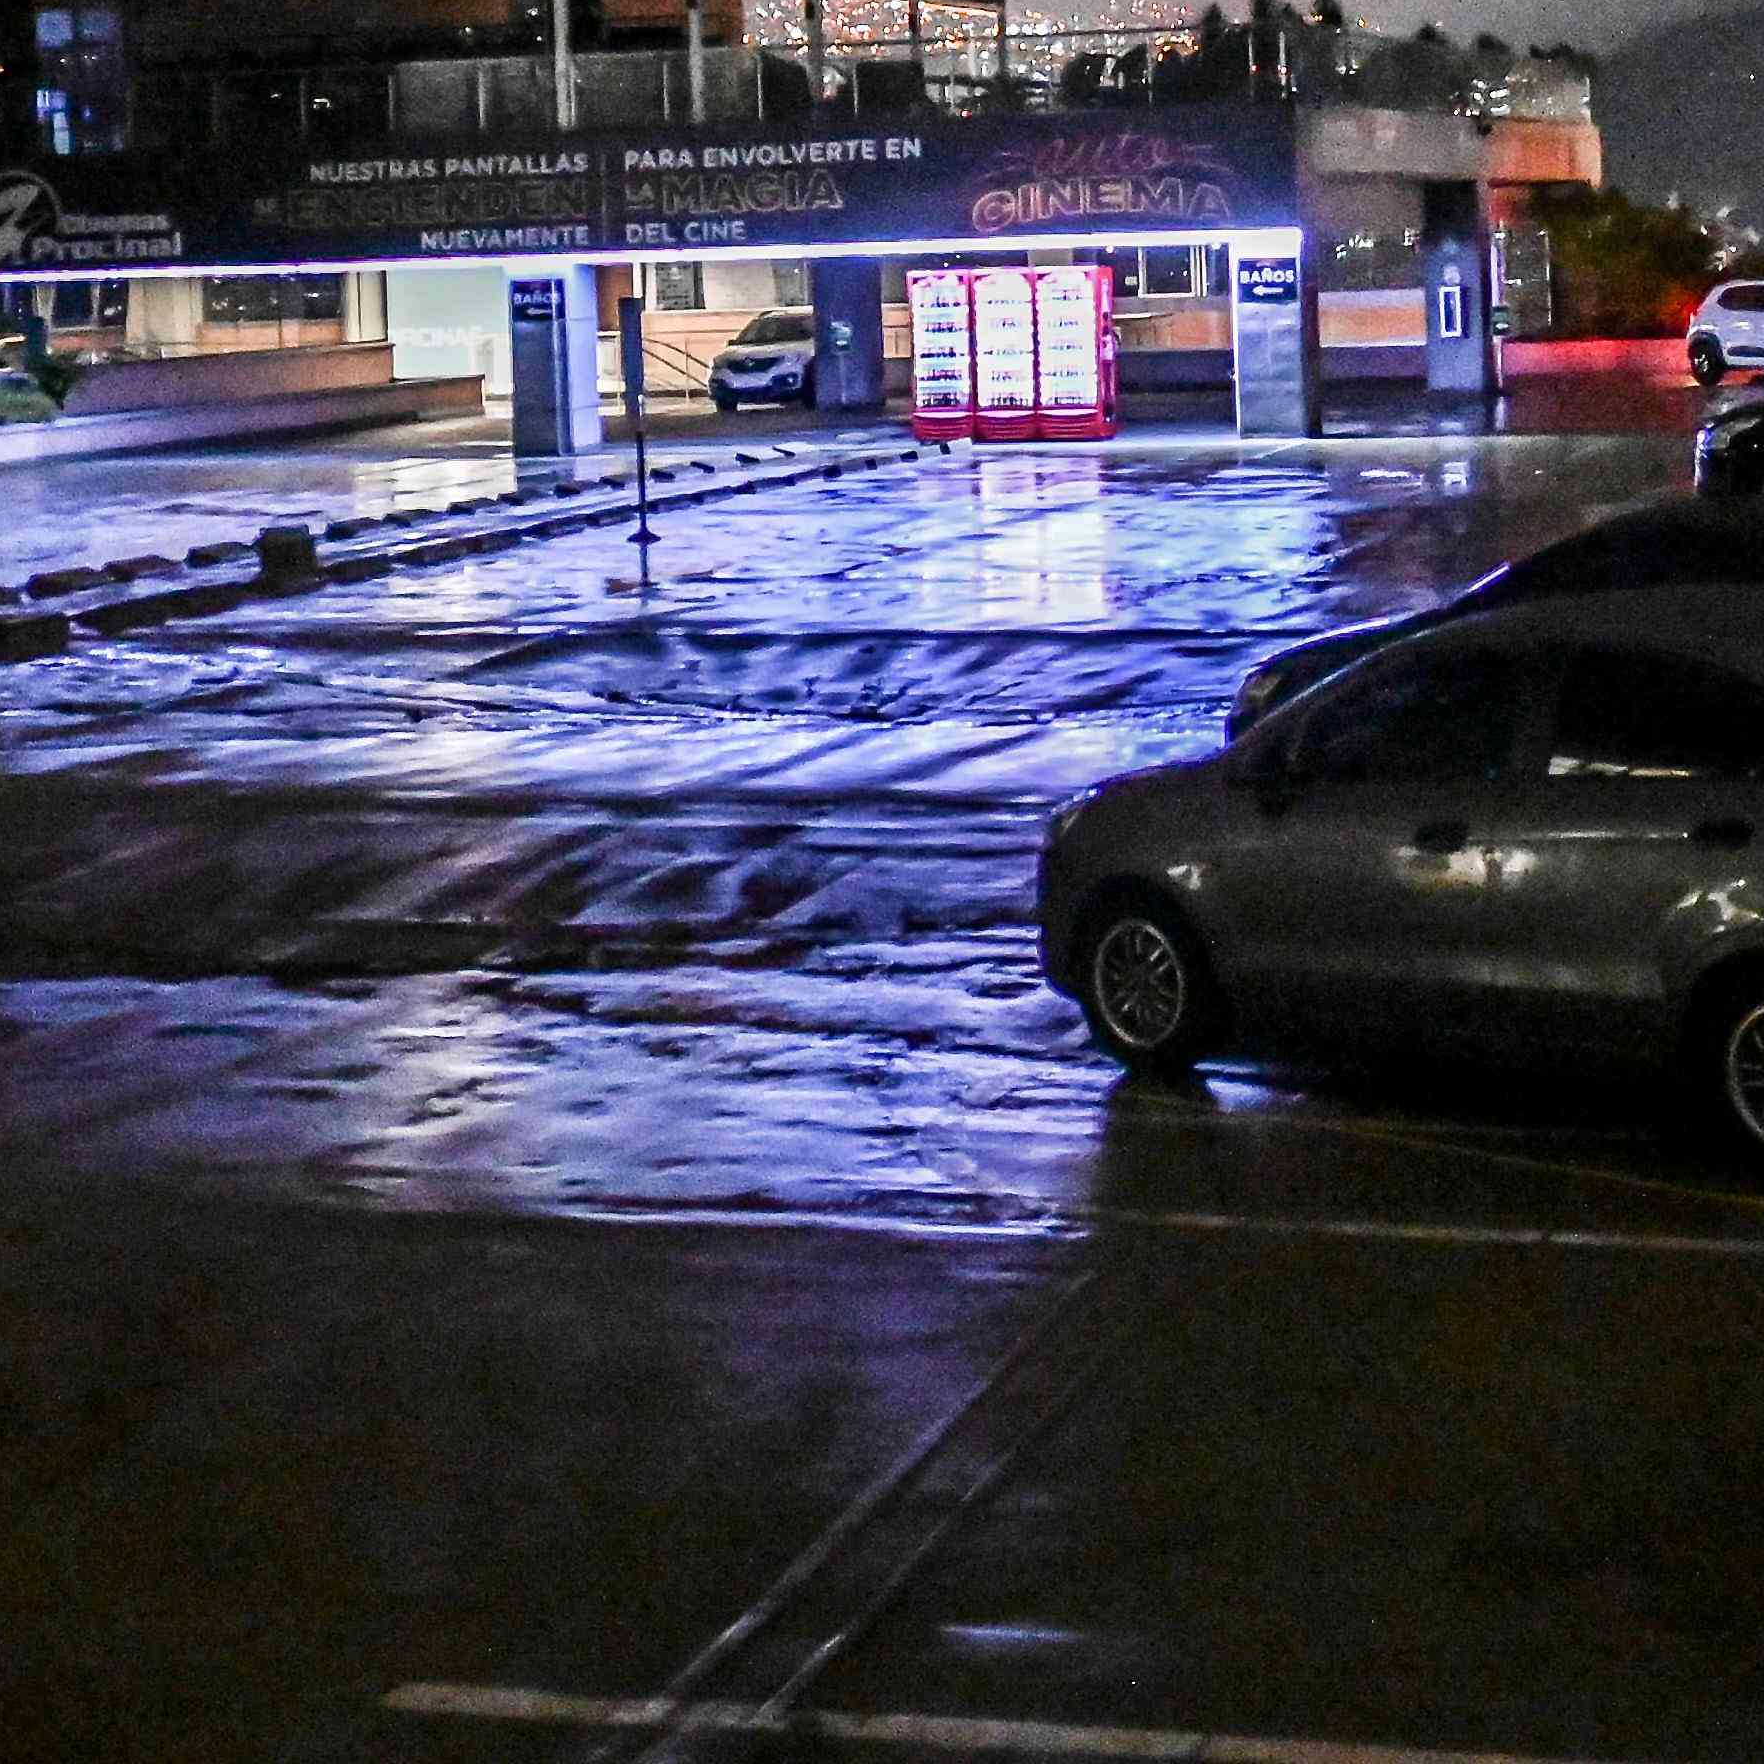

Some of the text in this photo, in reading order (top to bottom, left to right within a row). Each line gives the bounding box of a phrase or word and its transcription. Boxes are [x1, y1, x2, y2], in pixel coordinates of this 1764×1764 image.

[309, 153, 589, 183] NUESTRAS PANTALLAS
[624, 136, 922, 171] PARA ENVOLVERTE EN
[624, 168, 844, 215] LA MAGIA
[972, 177, 1231, 233] CINEMA
[31, 232, 182, 261] Procinal
[420, 225, 589, 250] NUEVAMENTE
[625, 220, 747, 245] DEL CINE
[1239, 265, 1295, 286] BAÑOS
